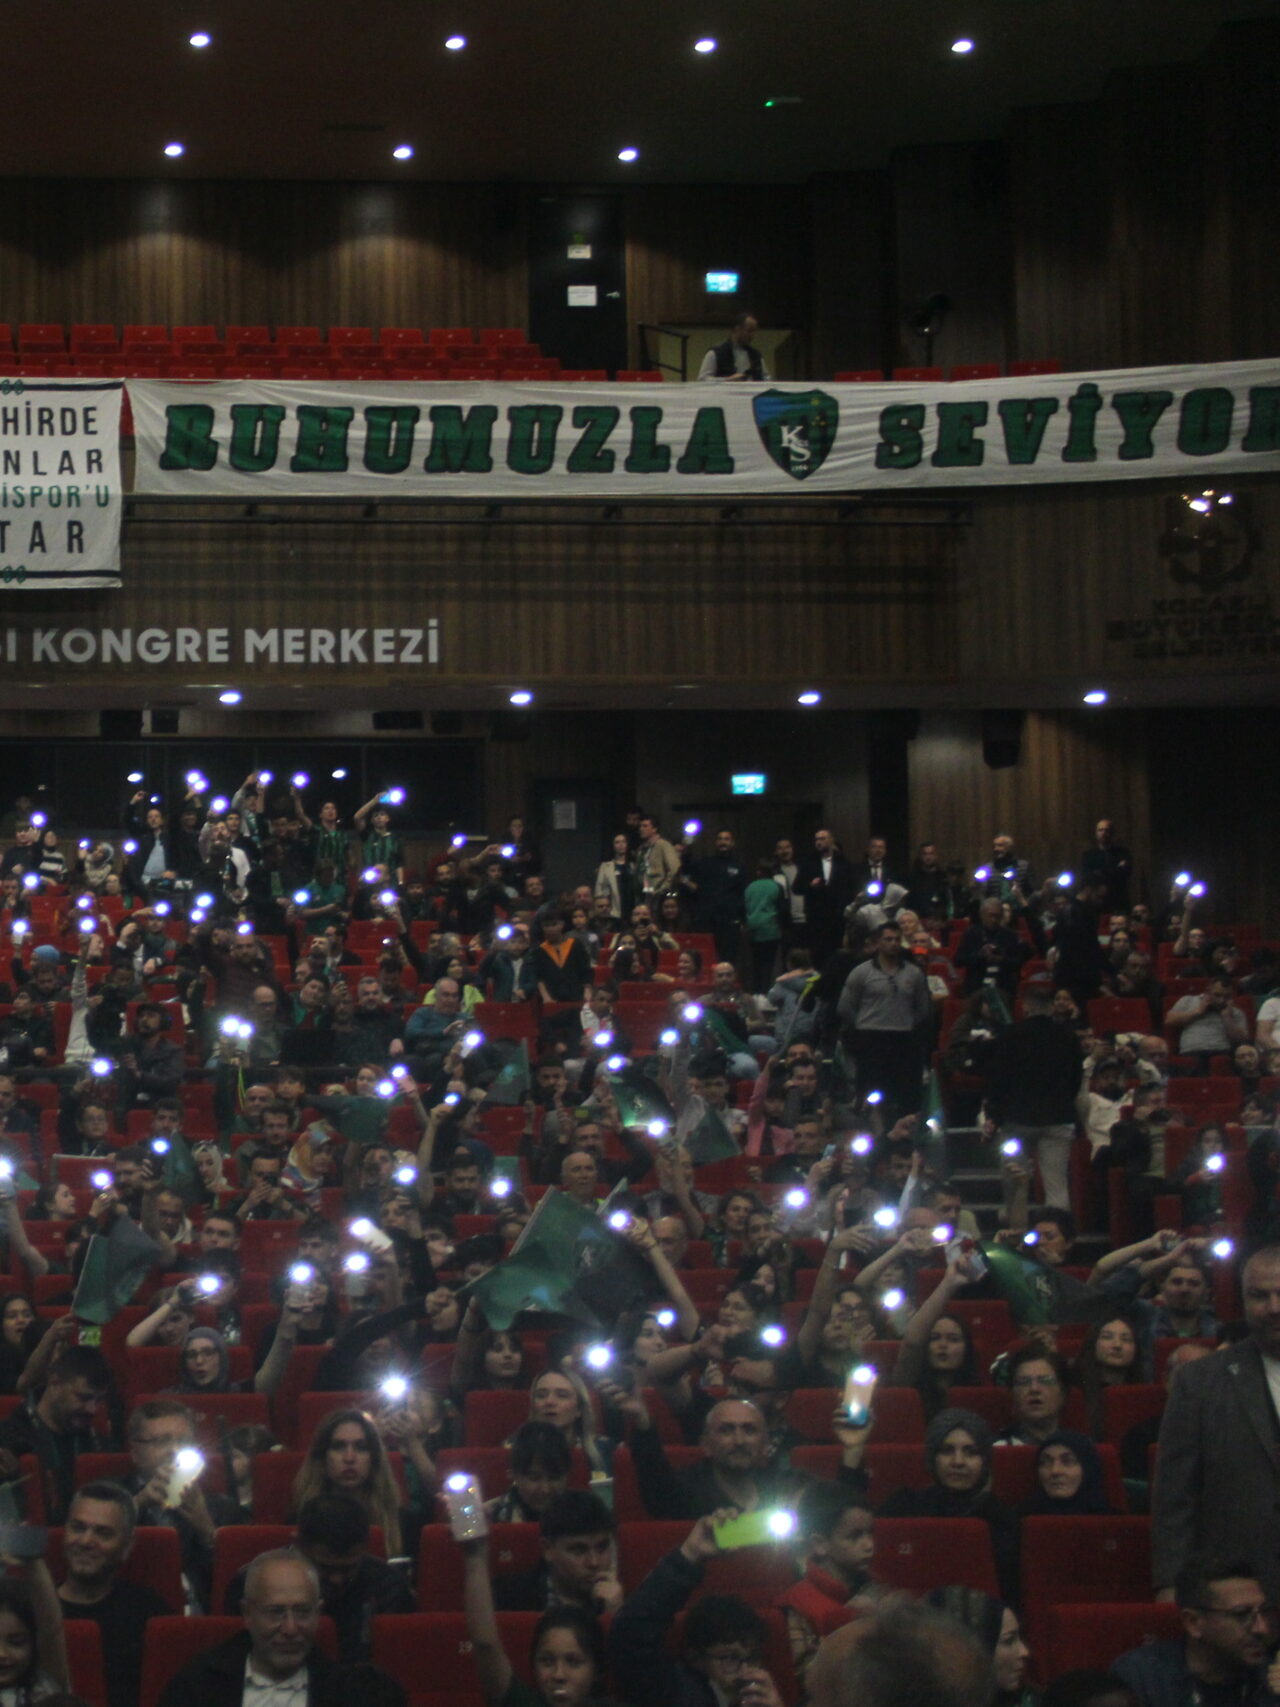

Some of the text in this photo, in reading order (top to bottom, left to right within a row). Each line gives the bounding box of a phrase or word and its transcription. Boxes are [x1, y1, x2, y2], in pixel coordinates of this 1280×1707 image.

[159, 403, 735, 474] RUHUMUZLA
[32, 627, 230, 663] KONGRE
[244, 618, 439, 663] MERKEZİ
